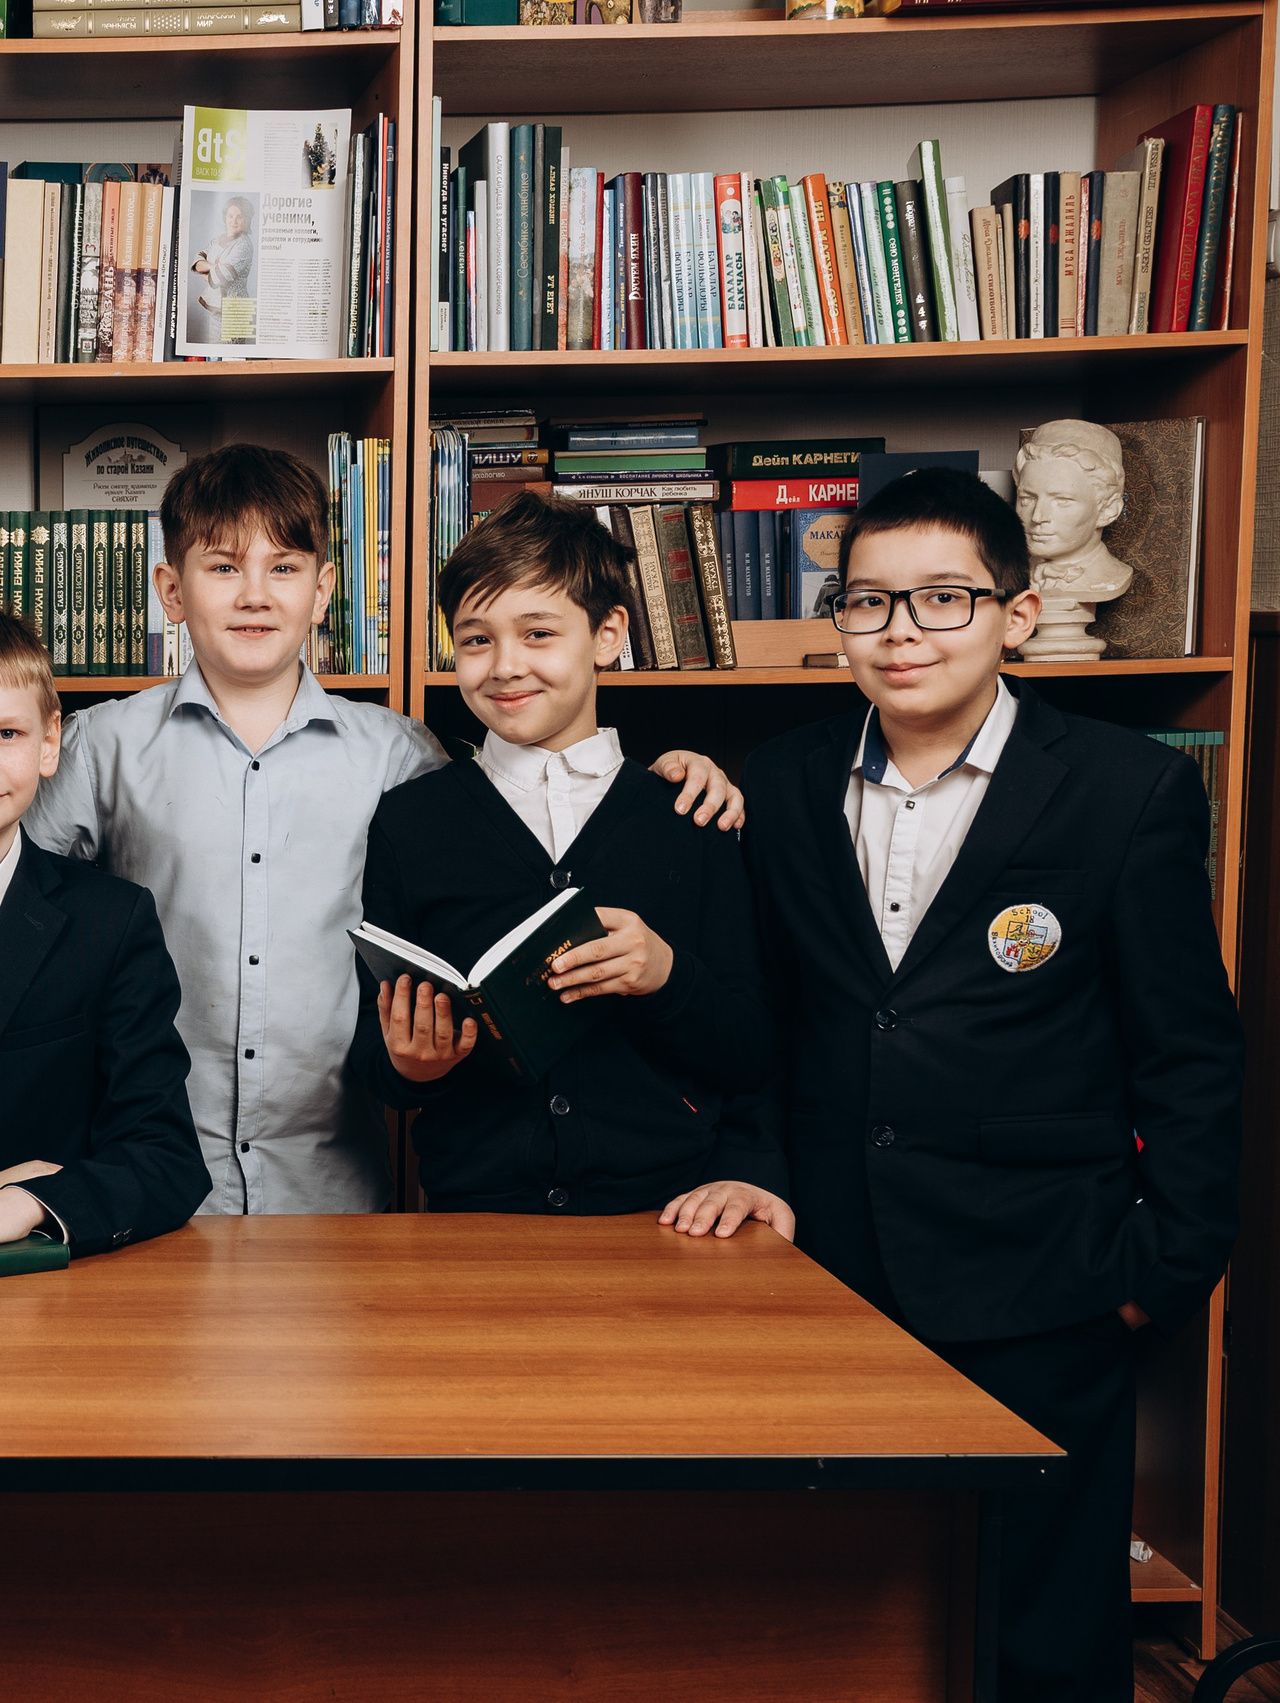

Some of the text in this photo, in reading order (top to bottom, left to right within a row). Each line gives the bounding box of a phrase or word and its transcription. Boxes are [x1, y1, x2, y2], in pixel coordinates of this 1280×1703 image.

[196, 20, 213, 28] МИР
[195, 167, 217, 176] BACK TO
[262, 193, 312, 209] Дорогие
[442, 204, 448, 215] не
[496, 177, 504, 211] САЙДАШЕВ
[517, 172, 528, 218] ханбикә
[814, 200, 824, 222] ИН
[262, 211, 315, 226] ученики,
[1064, 195, 1075, 277] МУСА ДЖАЛИЛЬ
[124, 235, 133, 266] Казани
[143, 235, 152, 266] Казани
[261, 235, 286, 244] родители
[818, 230, 834, 281] МАТУР
[888, 238, 897, 256] СӨЮ
[1116, 220, 1126, 286] МУСА ДЖАЛИЛЬ
[1177, 191, 1200, 322] МУСА МУСА
[628, 234, 642, 300] РУСТЕМ ЯХИН
[675, 251, 683, 312] ФОЛЬКЛОРЫ
[698, 251, 707, 312] ФОЛЬКЛОРЫ
[708, 250, 717, 298] БАЛАЛАР
[726, 254, 735, 310] БАЛАЛАР
[735, 252, 745, 310] БАКЧАСЫ
[982, 219, 997, 335] Муса Джалиль СТИХОТВОРЕНИЯ
[100, 266, 114, 332] КАЗАНЬ
[350, 258, 359, 339] ЭНЦИКЛОПЕДИЯСЕ
[546, 275, 555, 315] УТ ЕГЕТ
[1137, 291, 1147, 332] PROGRESS
[1197, 285, 1208, 324] МУСА
[120, 312, 129, 336] время
[119, 338, 127, 356] Как
[126, 436, 168, 466] путешествие
[752, 454, 789, 467] Дейл
[96, 464, 154, 475] по старой Казани
[578, 487, 657, 499] ЯНУШ КОРЧАК
[808, 483, 858, 502] КАРНЕ
[14, 551, 23, 586] ЕНИКИ
[56, 551, 64, 588] ИСХАКЫЙ
[74, 552, 82, 589] ИСХАКЫЙ
[134, 551, 142, 588] ИСХАКЫЙ
[34, 549, 44, 637] ӘМИРХАН ЕНИКИ
[1212, 800, 1221, 824] Татар
[1011, 908, 1048, 920] School
[1025, 915, 1035, 923] 18
